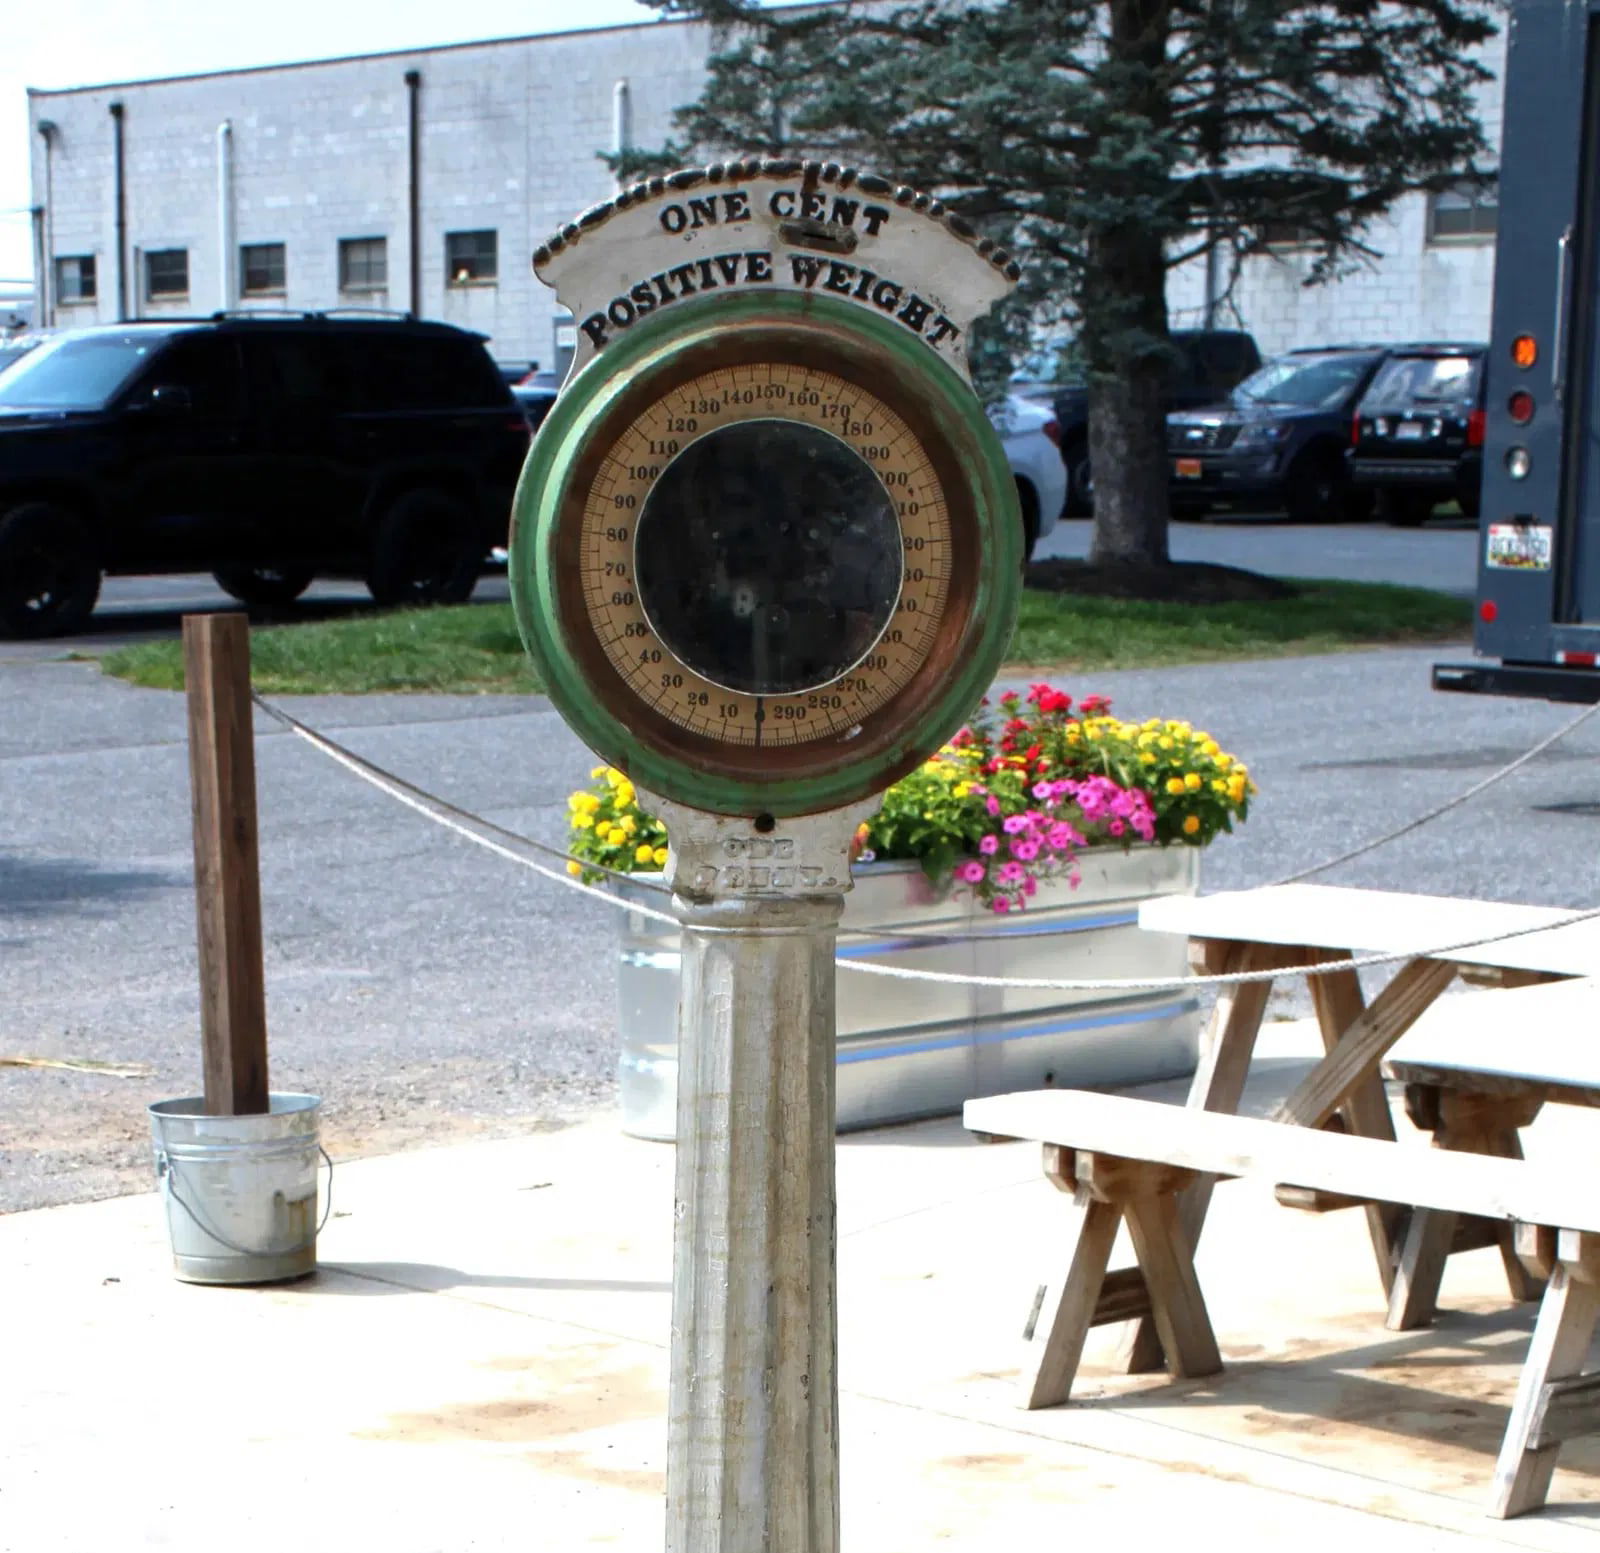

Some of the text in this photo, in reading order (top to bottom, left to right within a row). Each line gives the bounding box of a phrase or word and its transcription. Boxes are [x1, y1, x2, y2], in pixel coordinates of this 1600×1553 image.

[659, 190, 890, 236] ONE CENT
[579, 251, 961, 351] POSITIVE WEIGHT
[723, 389, 754, 405] 140
[755, 384, 786, 399] 150
[788, 391, 819, 406] 160
[689, 400, 721, 414] 130
[820, 404, 850, 418] 170
[666, 418, 697, 433] 120
[841, 422, 873, 437] 180
[649, 440, 679, 456] 110
[629, 465, 660, 481] 100
[614, 495, 636, 508] 90
[605, 528, 628, 542] 80
[605, 562, 627, 577] 70
[611, 592, 634, 606] 60
[624, 623, 648, 637] 50
[638, 649, 662, 663] 40
[660, 674, 683, 688] 30
[835, 678, 866, 692] 270
[807, 695, 842, 709] 280
[718, 704, 738, 718] 10
[773, 705, 806, 719] 290
